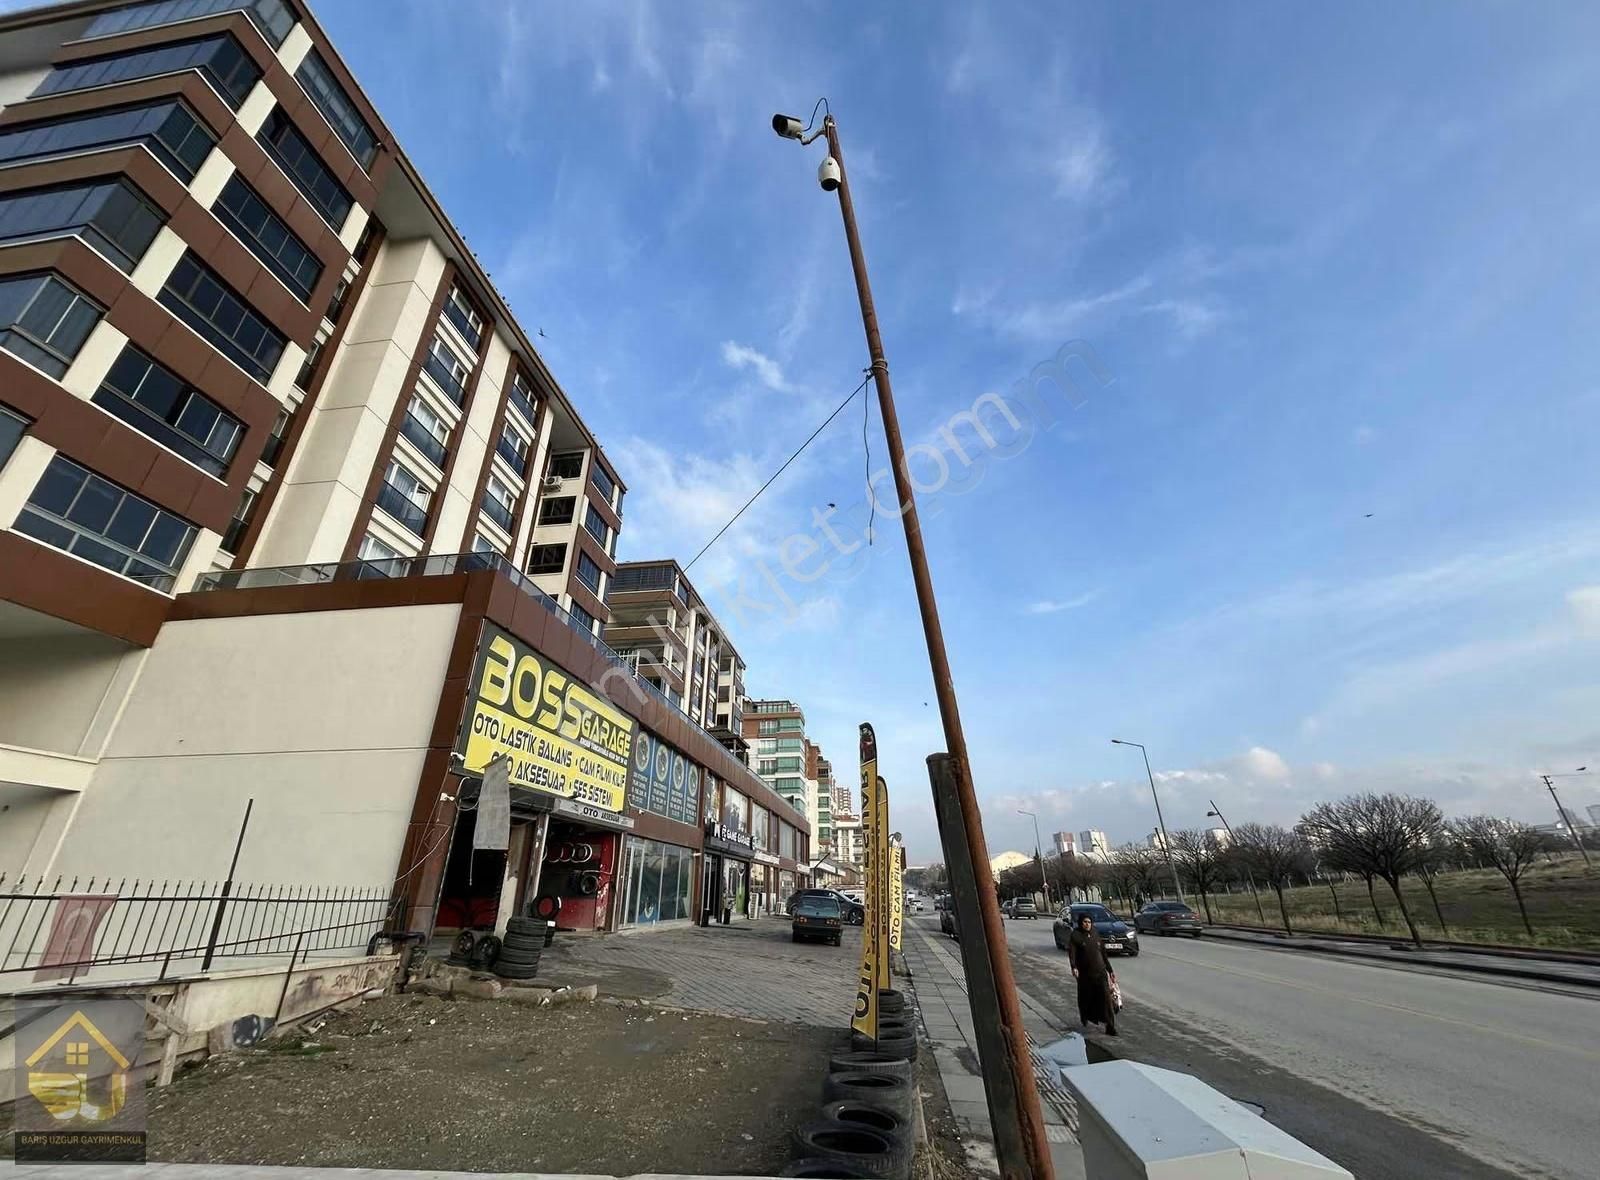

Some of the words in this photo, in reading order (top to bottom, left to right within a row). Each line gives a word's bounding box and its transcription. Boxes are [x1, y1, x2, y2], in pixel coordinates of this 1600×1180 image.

[479, 635, 632, 739] BOSS
[580, 710, 631, 758] GARAGE
[474, 713, 499, 740] OTO
[500, 723, 537, 754] LASTİK
[538, 739, 573, 768] BALANS
[579, 757, 595, 777] CAM
[515, 761, 566, 792] AKSESUAR
[573, 779, 588, 799] SES
[583, 807, 598, 818] OTO
[890, 917, 900, 945] OTO
